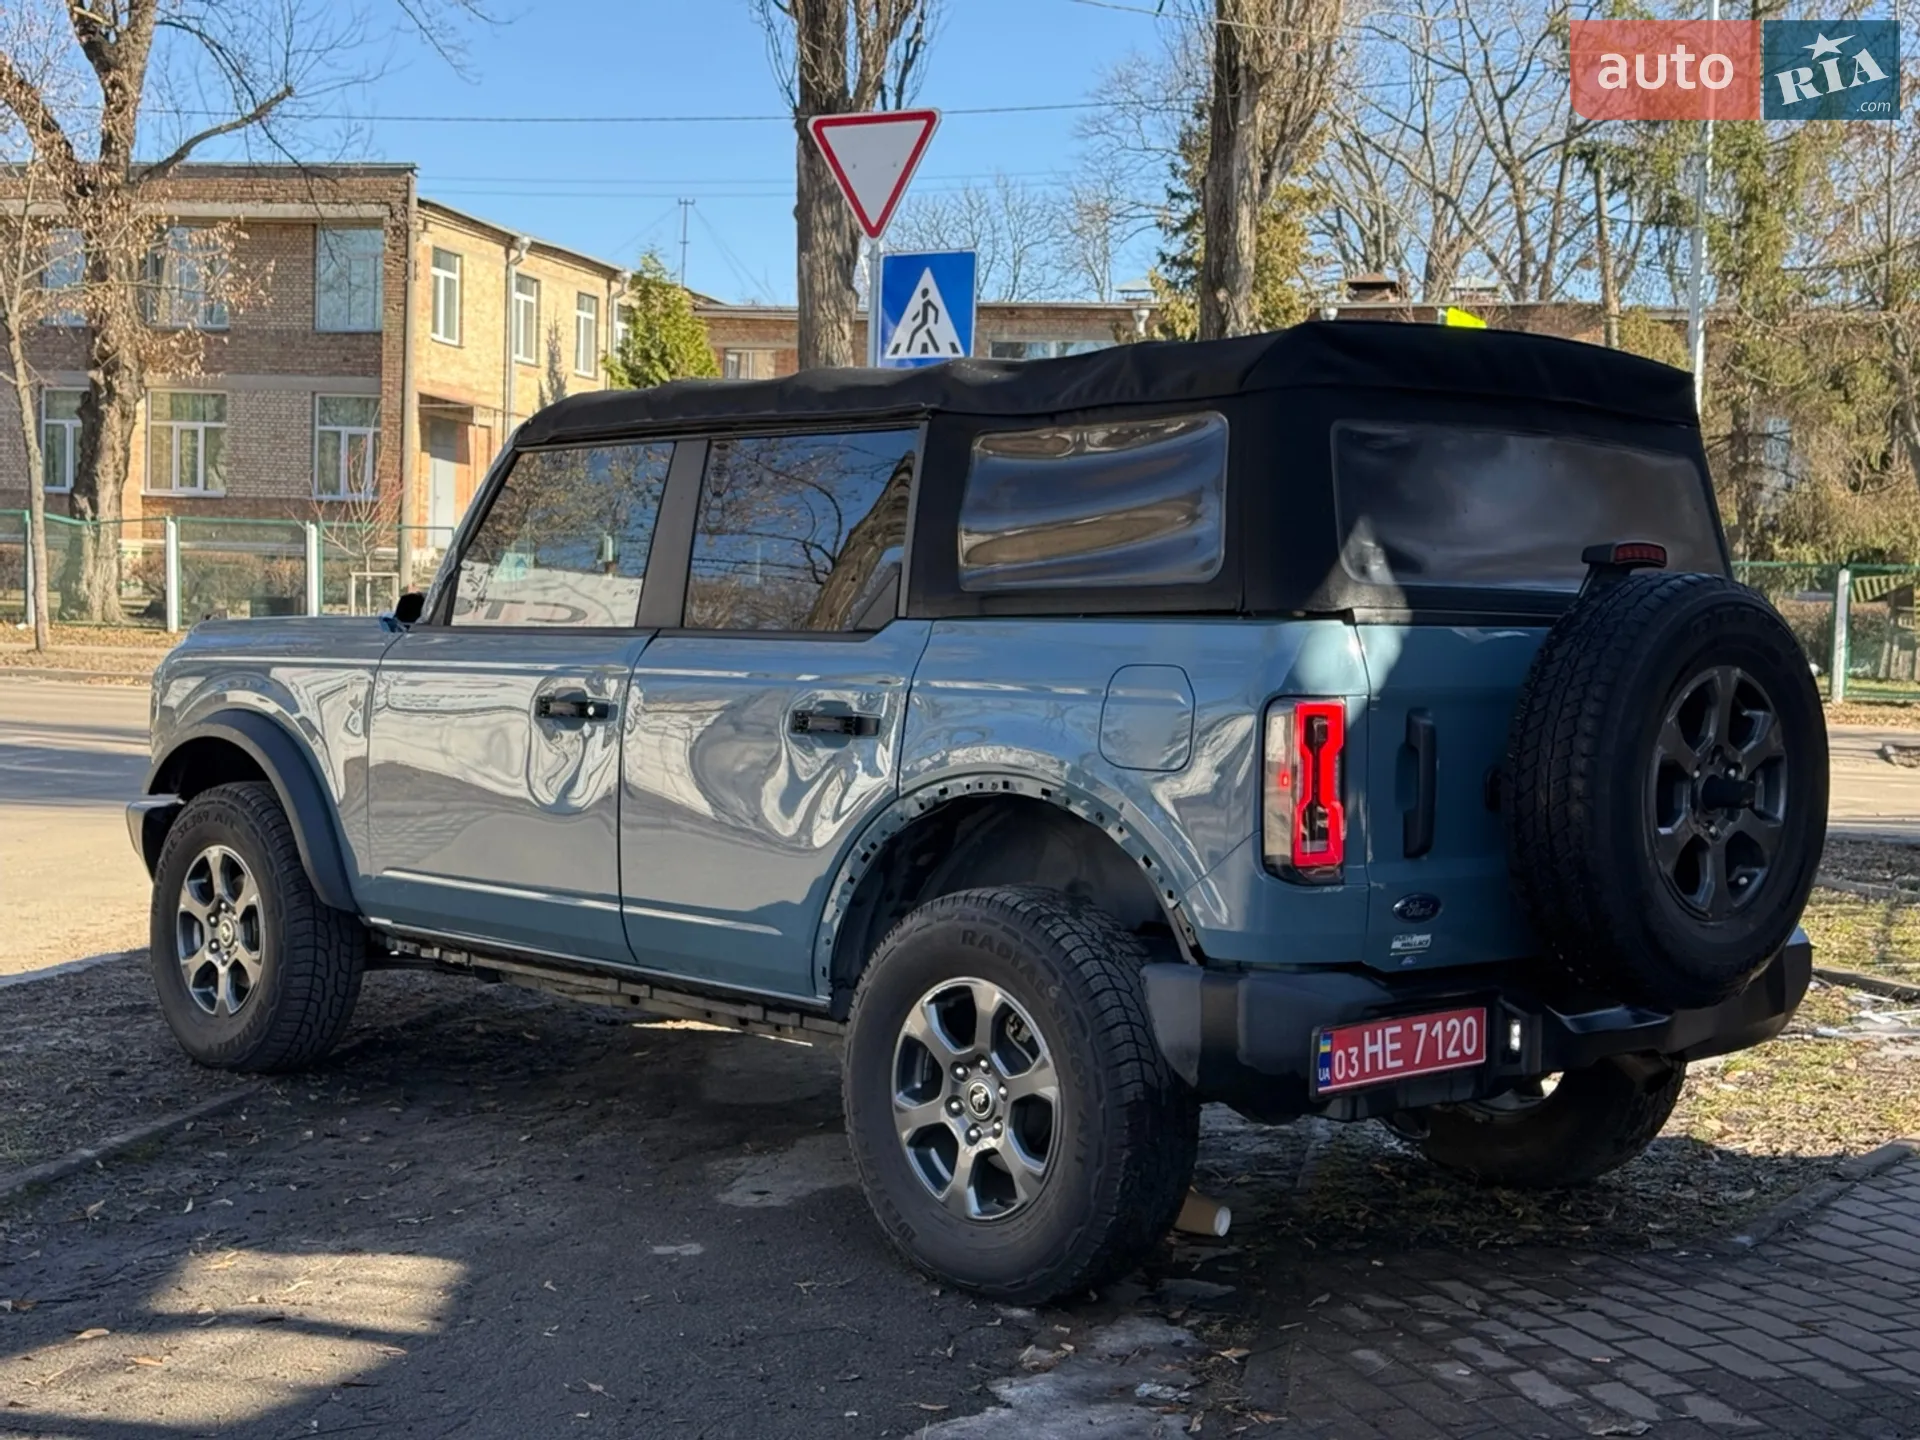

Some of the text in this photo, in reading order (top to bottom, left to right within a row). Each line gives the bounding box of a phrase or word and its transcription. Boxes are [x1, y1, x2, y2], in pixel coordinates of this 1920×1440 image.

[960, 928, 1047, 1001] RADIAL
[1318, 1067, 1331, 1081] UA
[1334, 1016, 1478, 1080] 03 HE 7120
